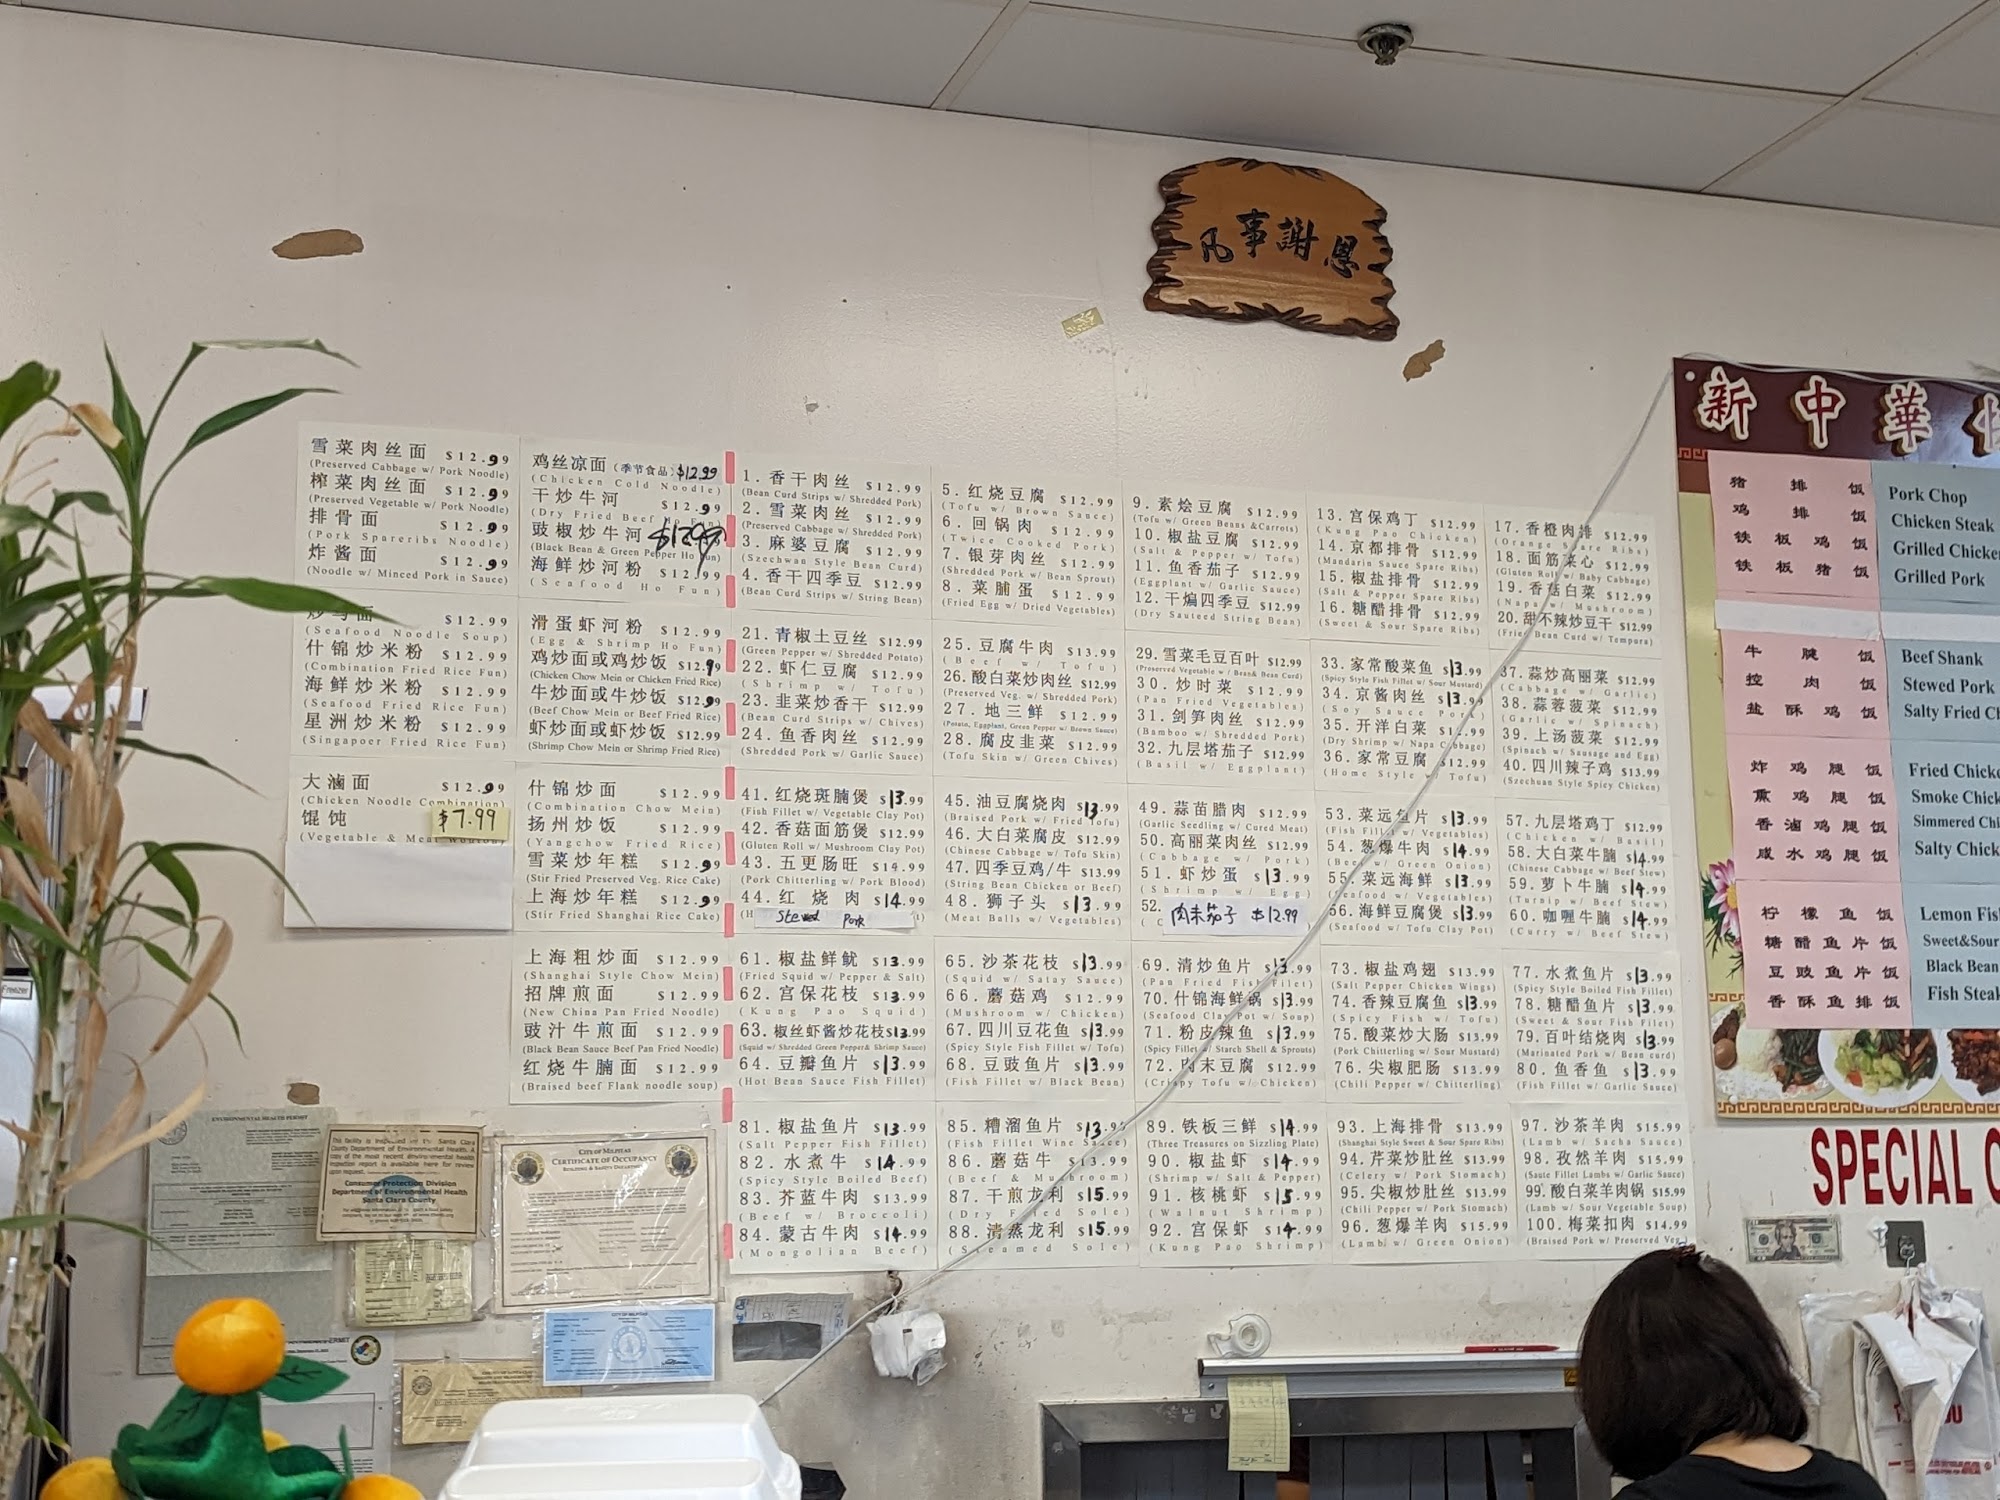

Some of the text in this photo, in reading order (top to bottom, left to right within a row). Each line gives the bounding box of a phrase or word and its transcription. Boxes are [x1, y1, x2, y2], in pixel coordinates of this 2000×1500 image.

[311, 437, 509, 467] 雪菜肉丝面 $12.99
[309, 458, 367, 471] (Preserved
[371, 462, 417, 475] Cabbage
[439, 466, 463, 477] Pork
[468, 468, 509, 481] Noodle)
[532, 452, 607, 473] 鸡丝凉面
[309, 471, 427, 495] 榨菜肉丝面
[769, 469, 850, 490] 香干肉丝
[866, 481, 921, 494] $12.99
[1729, 475, 1866, 496] 猪排饭
[532, 487, 721, 516] 干炒牛河 $12.99
[741, 487, 770, 497] (Bean
[773, 490, 797, 499] Curd
[801, 491, 830, 503] Strips
[849, 494, 892, 506] Shredded
[896, 498, 922, 509] Pork)
[1889, 486, 1968, 508] Pork Chop
[309, 506, 379, 528] 排骨面
[1732, 502, 1867, 524] 鸡排饭
[1891, 513, 1995, 533] Chicken Steak
[531, 520, 642, 544] 豉椒炒牛河
[1733, 530, 1869, 551] 铁板鸡饭
[308, 542, 377, 563] 炸酱面
[1893, 540, 2000, 561] Grilled Chicke
[530, 555, 642, 578] 海鲜炒河粉
[1734, 558, 1870, 579] 铁板猪饭
[1894, 568, 1985, 587] Grilled Pork
[531, 613, 721, 639] 滑蛋虾河粉 $12.99
[774, 626, 868, 646] 青椒土豆丝
[879, 637, 923, 649] $12.99
[305, 638, 507, 663] 什锦炒米粉 $12.99
[530, 648, 667, 671] 鸡炒面或鸡炒饭
[1901, 648, 1984, 667] Beef Shank
[304, 674, 507, 698] 海鲜炒米粉 $12.99
[530, 683, 667, 705] 牛炒面或牛炒饭
[1903, 676, 1995, 695] Stewed Pork
[1745, 701, 1878, 720] 盐酥鸡饭
[1904, 703, 1940, 722] Salty
[1944, 704, 1981, 720] Fried
[303, 711, 506, 734] 星洲炒米粉 $12.99
[528, 718, 721, 742] 虾炒面或虾炒饭 $12.99
[1532, 758, 1612, 777] 四川辣子鸡
[1621, 767, 1660, 778] $13.99
[1749, 759, 1883, 778] 炸鸡腿饭
[1909, 762, 1949, 778] Fried
[527, 778, 721, 800] 什锦炒面 $12.99
[1911, 788, 1959, 805] Smoke
[301, 809, 347, 827] 馄饨
[438, 807, 496, 833] $7.99
[527, 814, 721, 835] 扬州炒饭 $12.99
[1913, 814, 1975, 829] Simmered
[976, 825, 1067, 845] 大白菜腐皮
[1077, 834, 1120, 846] $12.99
[1914, 840, 1952, 860] Salty
[527, 851, 638, 870] 雪菜炒年糕
[526, 887, 638, 906] 上海炒年糕
[842, 912, 866, 929] Pork
[1251, 905, 1298, 925] $12.99
[1920, 906, 2000, 922] Lemon Fis
[1764, 935, 1898, 951] 糖醋鱼片饭
[1923, 933, 2000, 948] Sweet&Sour
[524, 948, 719, 966] 上海粗炒面 $12.99
[1926, 959, 1999, 973] Black Bean
[523, 970, 719, 982] (Shanghai Style Chow Mein)
[524, 984, 719, 1003] 招牌煎面 $12.99
[1767, 993, 1901, 1010] 香酥鱼排饭
[1927, 985, 1959, 1001] Fish
[523, 1020, 719, 1040] 豉汁牛煎面 $12.99
[522, 1057, 718, 1077] 红烧牛腩面 $12.99
[1372, 1117, 1443, 1135] 上海排骨
[1455, 1122, 1503, 1134] $13.99
[1554, 1116, 1624, 1134] 沙茶羊肉
[1636, 1122, 1681, 1133] $15.99
[1810, 1126, 1973, 1207] SPECIAL
[331, 1188, 373, 1196] Department
[778, 1187, 858, 1207] 芥蓝牛肉
[873, 1193, 928, 1205] $13.99
